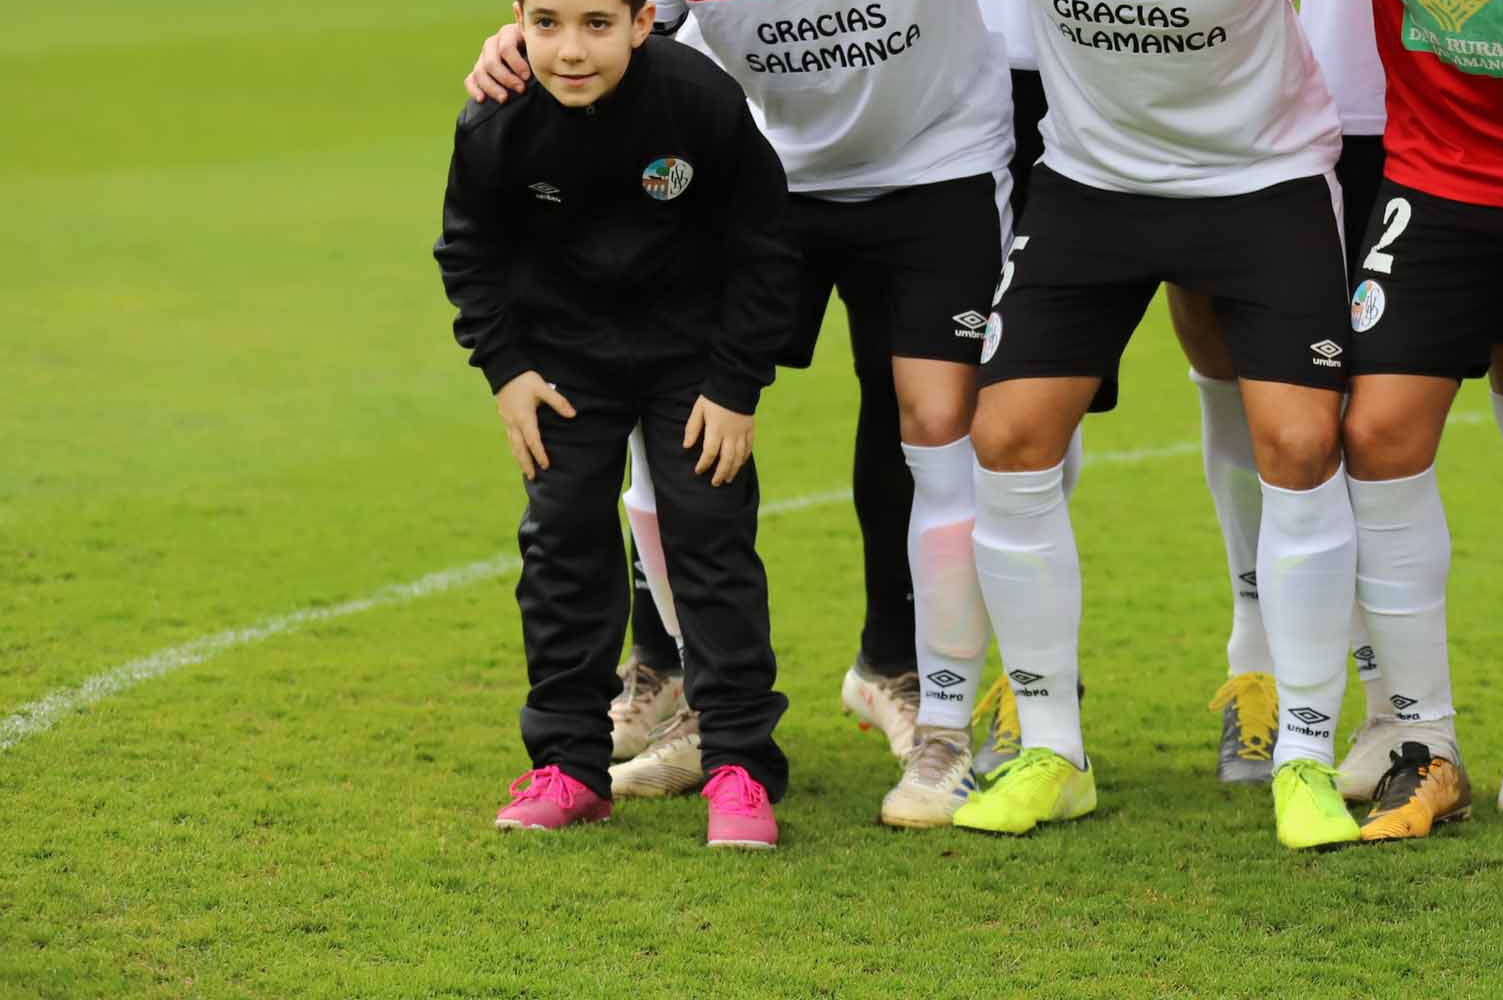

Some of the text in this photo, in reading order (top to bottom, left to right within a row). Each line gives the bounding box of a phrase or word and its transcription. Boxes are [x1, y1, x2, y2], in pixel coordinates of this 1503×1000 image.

[757, 4, 887, 44] GRACIAS
[746, 24, 921, 73] SALAMANCA
[1057, 23, 1226, 53] ALAMANCA
[1362, 197, 1412, 274] 2
[955, 329, 985, 340] umbr
[1015, 688, 1048, 697] mbro
[1397, 712, 1420, 721] bro
[1288, 723, 1329, 738] umbro
